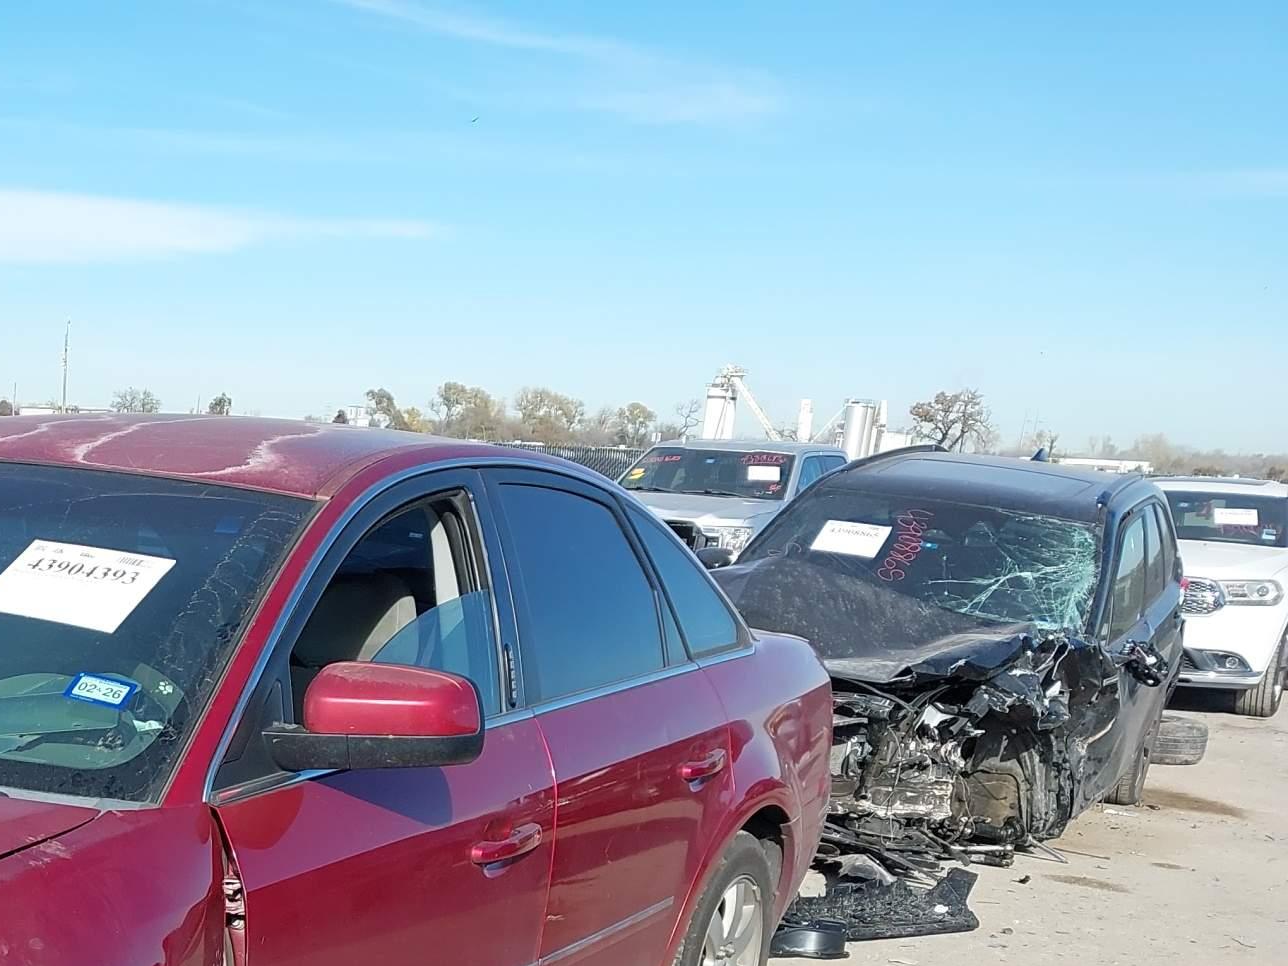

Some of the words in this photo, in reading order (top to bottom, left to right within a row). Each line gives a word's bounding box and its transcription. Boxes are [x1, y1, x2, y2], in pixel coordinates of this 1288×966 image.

[27, 558, 140, 585] 43904393
[78, 682, 97, 693] 02
[102, 687, 122, 699] 26
